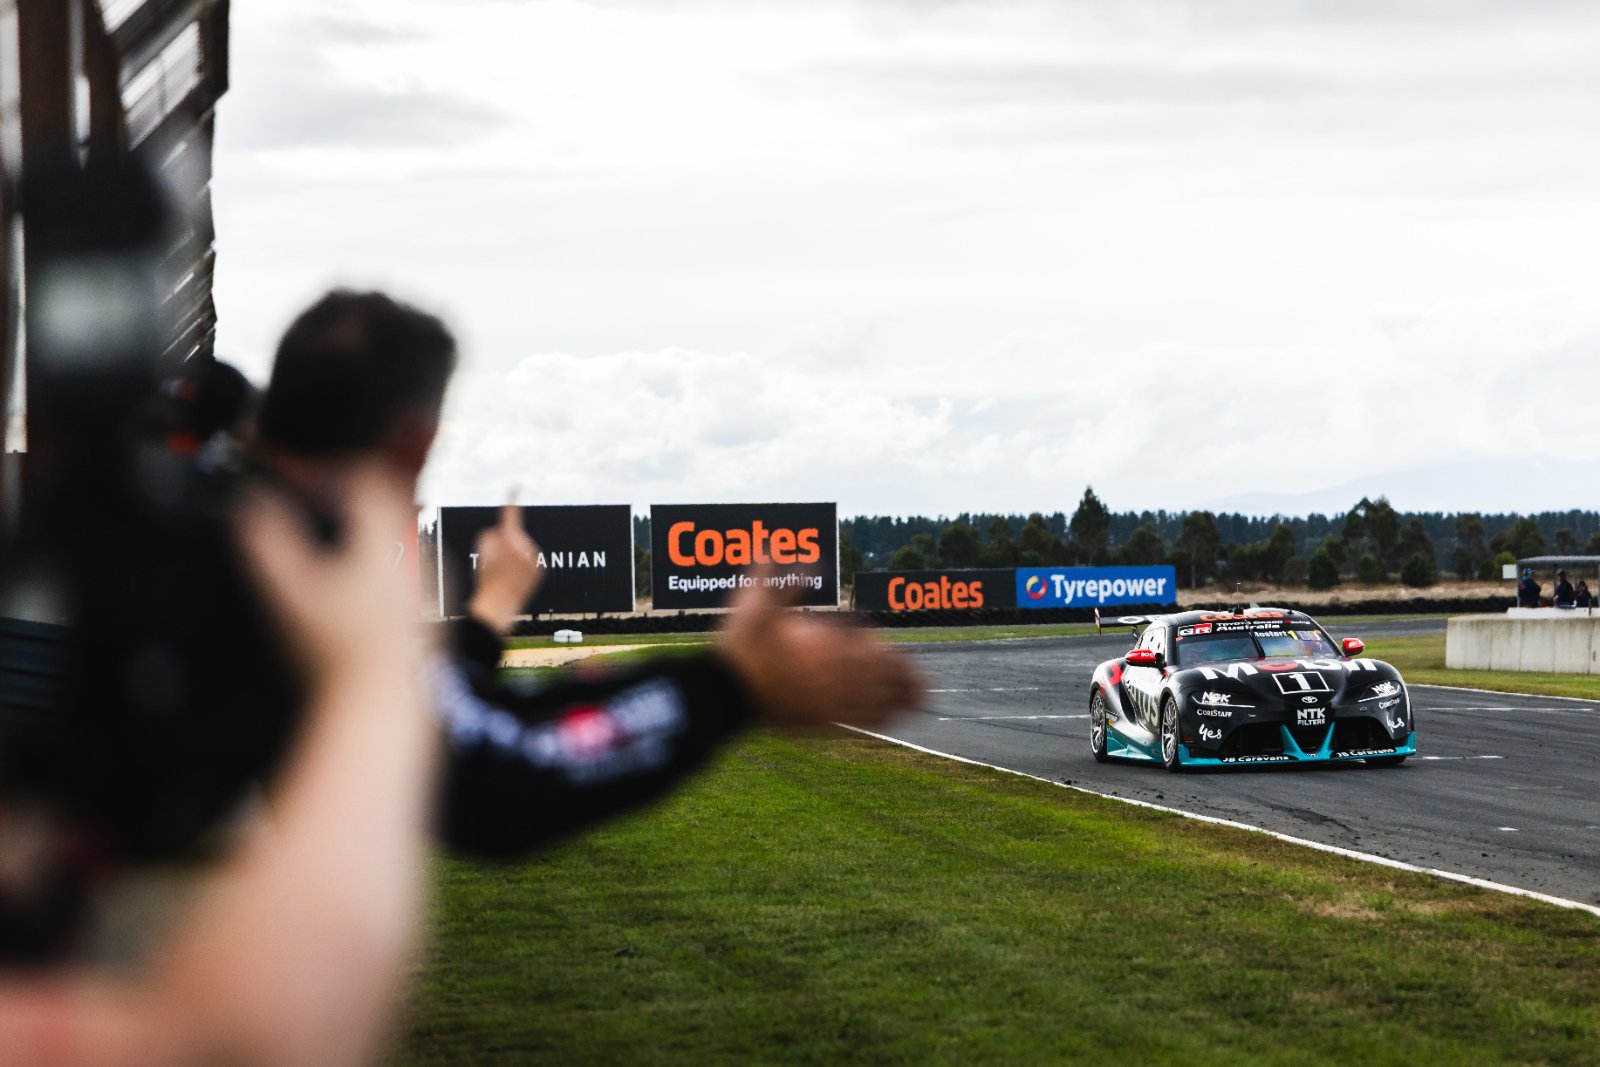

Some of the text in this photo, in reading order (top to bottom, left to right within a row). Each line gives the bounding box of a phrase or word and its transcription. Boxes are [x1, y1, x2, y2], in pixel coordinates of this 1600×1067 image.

[667, 520, 821, 567] Coates
[469, 551, 607, 571] TANIAN
[668, 573, 823, 593] Equipped for anything
[1050, 574, 1167, 605] Tyrepower
[887, 575, 984, 610] Coates
[1180, 624, 1211, 636] GR
[1216, 623, 1280, 632] Australia
[1289, 673, 1312, 690] 1
[1297, 707, 1325, 720] NTK
[1238, 755, 1289, 763] Caravans
